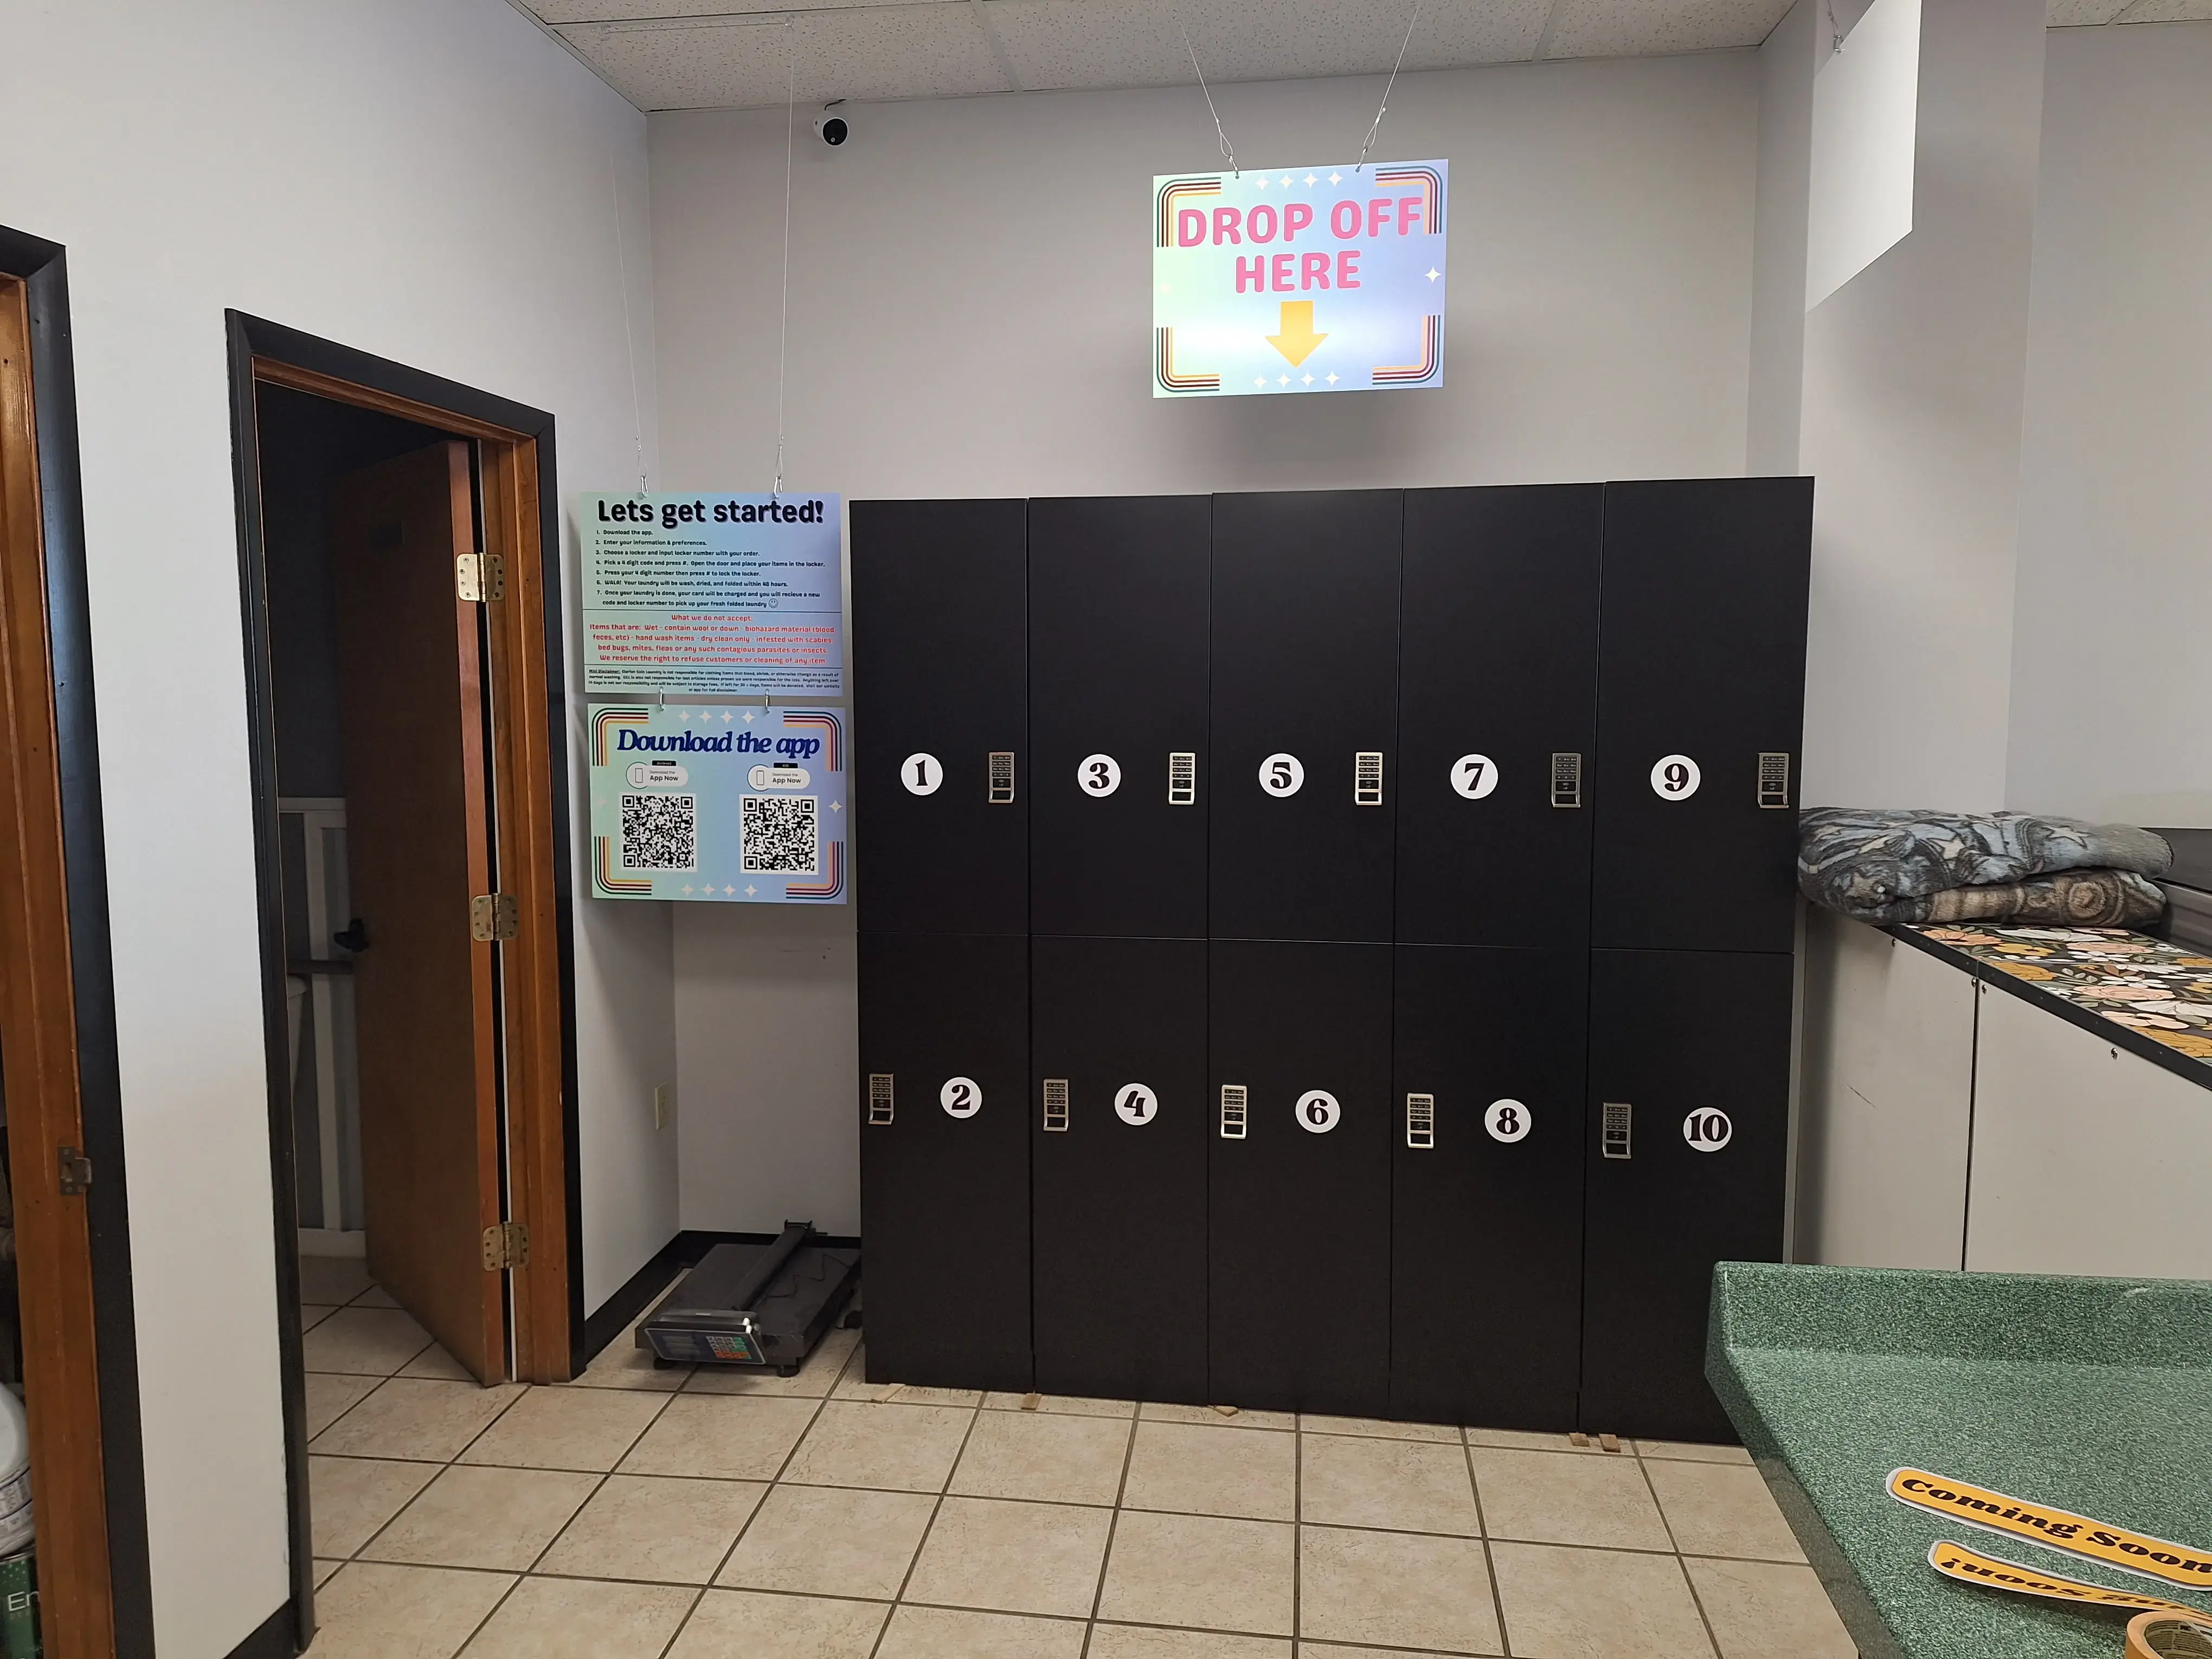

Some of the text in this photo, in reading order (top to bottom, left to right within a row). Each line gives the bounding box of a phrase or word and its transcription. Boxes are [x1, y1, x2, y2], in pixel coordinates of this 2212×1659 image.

[1178, 197, 1423, 247] DROP OFF
[1236, 250, 1361, 293] HERE
[597, 499, 824, 529] Lets get started!
[617, 729, 820, 759] Download the app
[915, 760, 928, 786] 1
[1088, 762, 1110, 789] 3
[1270, 762, 1292, 789] 5
[1464, 763, 1485, 790] 7
[1664, 763, 1689, 792] 9
[951, 1085, 971, 1110] 2
[1124, 1091, 1146, 1117] 4
[1307, 1098, 1329, 1125] 6
[1496, 1108, 1520, 1134] 8
[1689, 1114, 1729, 1142] 10
[1902, 1479, 2084, 1539] Coming
